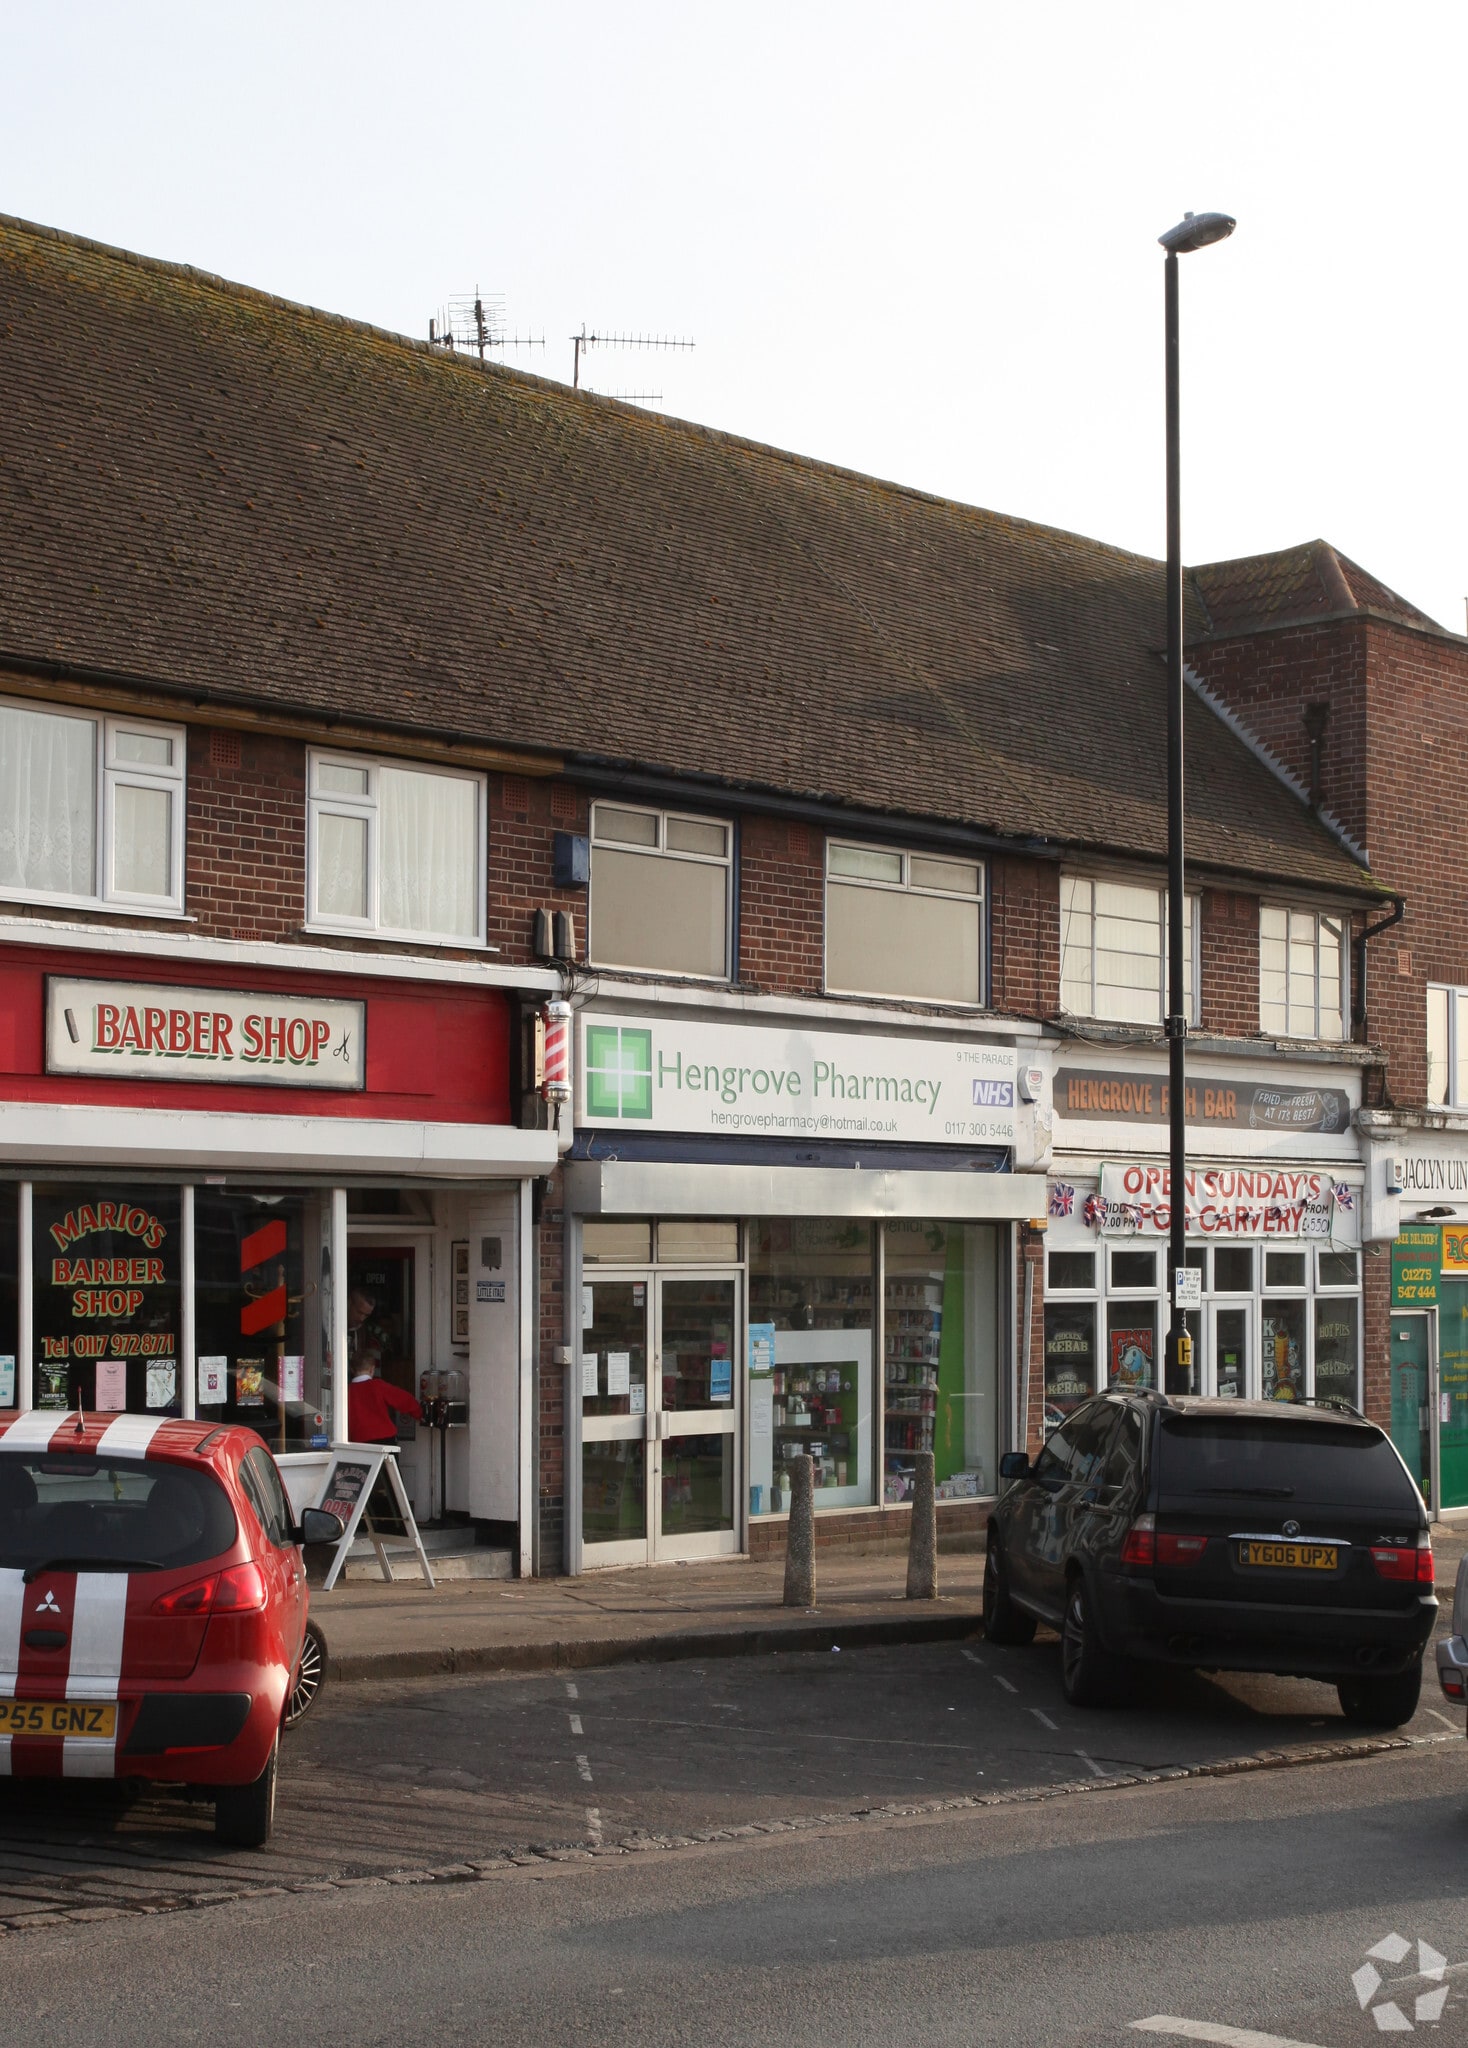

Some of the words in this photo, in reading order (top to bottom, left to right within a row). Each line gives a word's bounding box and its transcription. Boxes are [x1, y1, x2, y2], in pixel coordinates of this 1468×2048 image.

[91, 1003, 234, 1061] BARBER
[240, 1014, 331, 1066] SHOP
[956, 1051, 962, 1062] 9
[964, 1051, 980, 1063] THE
[982, 1053, 1014, 1066] PARADE
[658, 1050, 801, 1105] Hengrove
[813, 1060, 942, 1115] Pharmacy
[973, 1080, 1013, 1107] NHS
[1068, 1079, 1153, 1114] HENGROVE
[1160, 1085, 1197, 1118] FH
[1204, 1087, 1237, 1120] BAR
[1259, 1092, 1280, 1106] FRIED
[1291, 1094, 1316, 1107] FRESH
[711, 1110, 898, 1132] hengrovepharmacy@hotmail.co.uk
[1264, 1107, 1276, 1119] AT
[1293, 1107, 1316, 1121] BEST!
[945, 1121, 966, 1136] 0117
[969, 1122, 987, 1137] 300
[990, 1123, 1014, 1138] 5446
[1204, 1171, 1321, 1200] SUNDAY'S
[1402, 1158, 1445, 1190] JACLYN
[1200, 1204, 1305, 1233] CARVERY
[1305, 1203, 1329, 1215] FROM
[50, 1201, 168, 1252] MARIO'S
[52, 1258, 166, 1286] BARBER
[1401, 1267, 1432, 1281] 01275
[1397, 1285, 1417, 1298] 547
[1417, 1285, 1437, 1298] 444
[72, 1289, 144, 1318] SHOP
[1319, 1323, 1333, 1338] HOT
[1335, 1323, 1350, 1337] PIES
[73, 1334, 109, 1358] 0117
[1047, 1340, 1089, 1354] KEBAB
[1110, 1327, 1153, 1377] FISH
[1047, 1381, 1088, 1396] KEBAB
[1375, 1535, 1408, 1544] X5
[1301, 1547, 1334, 1566] UPX
[51, 1706, 104, 1732] GNZ
